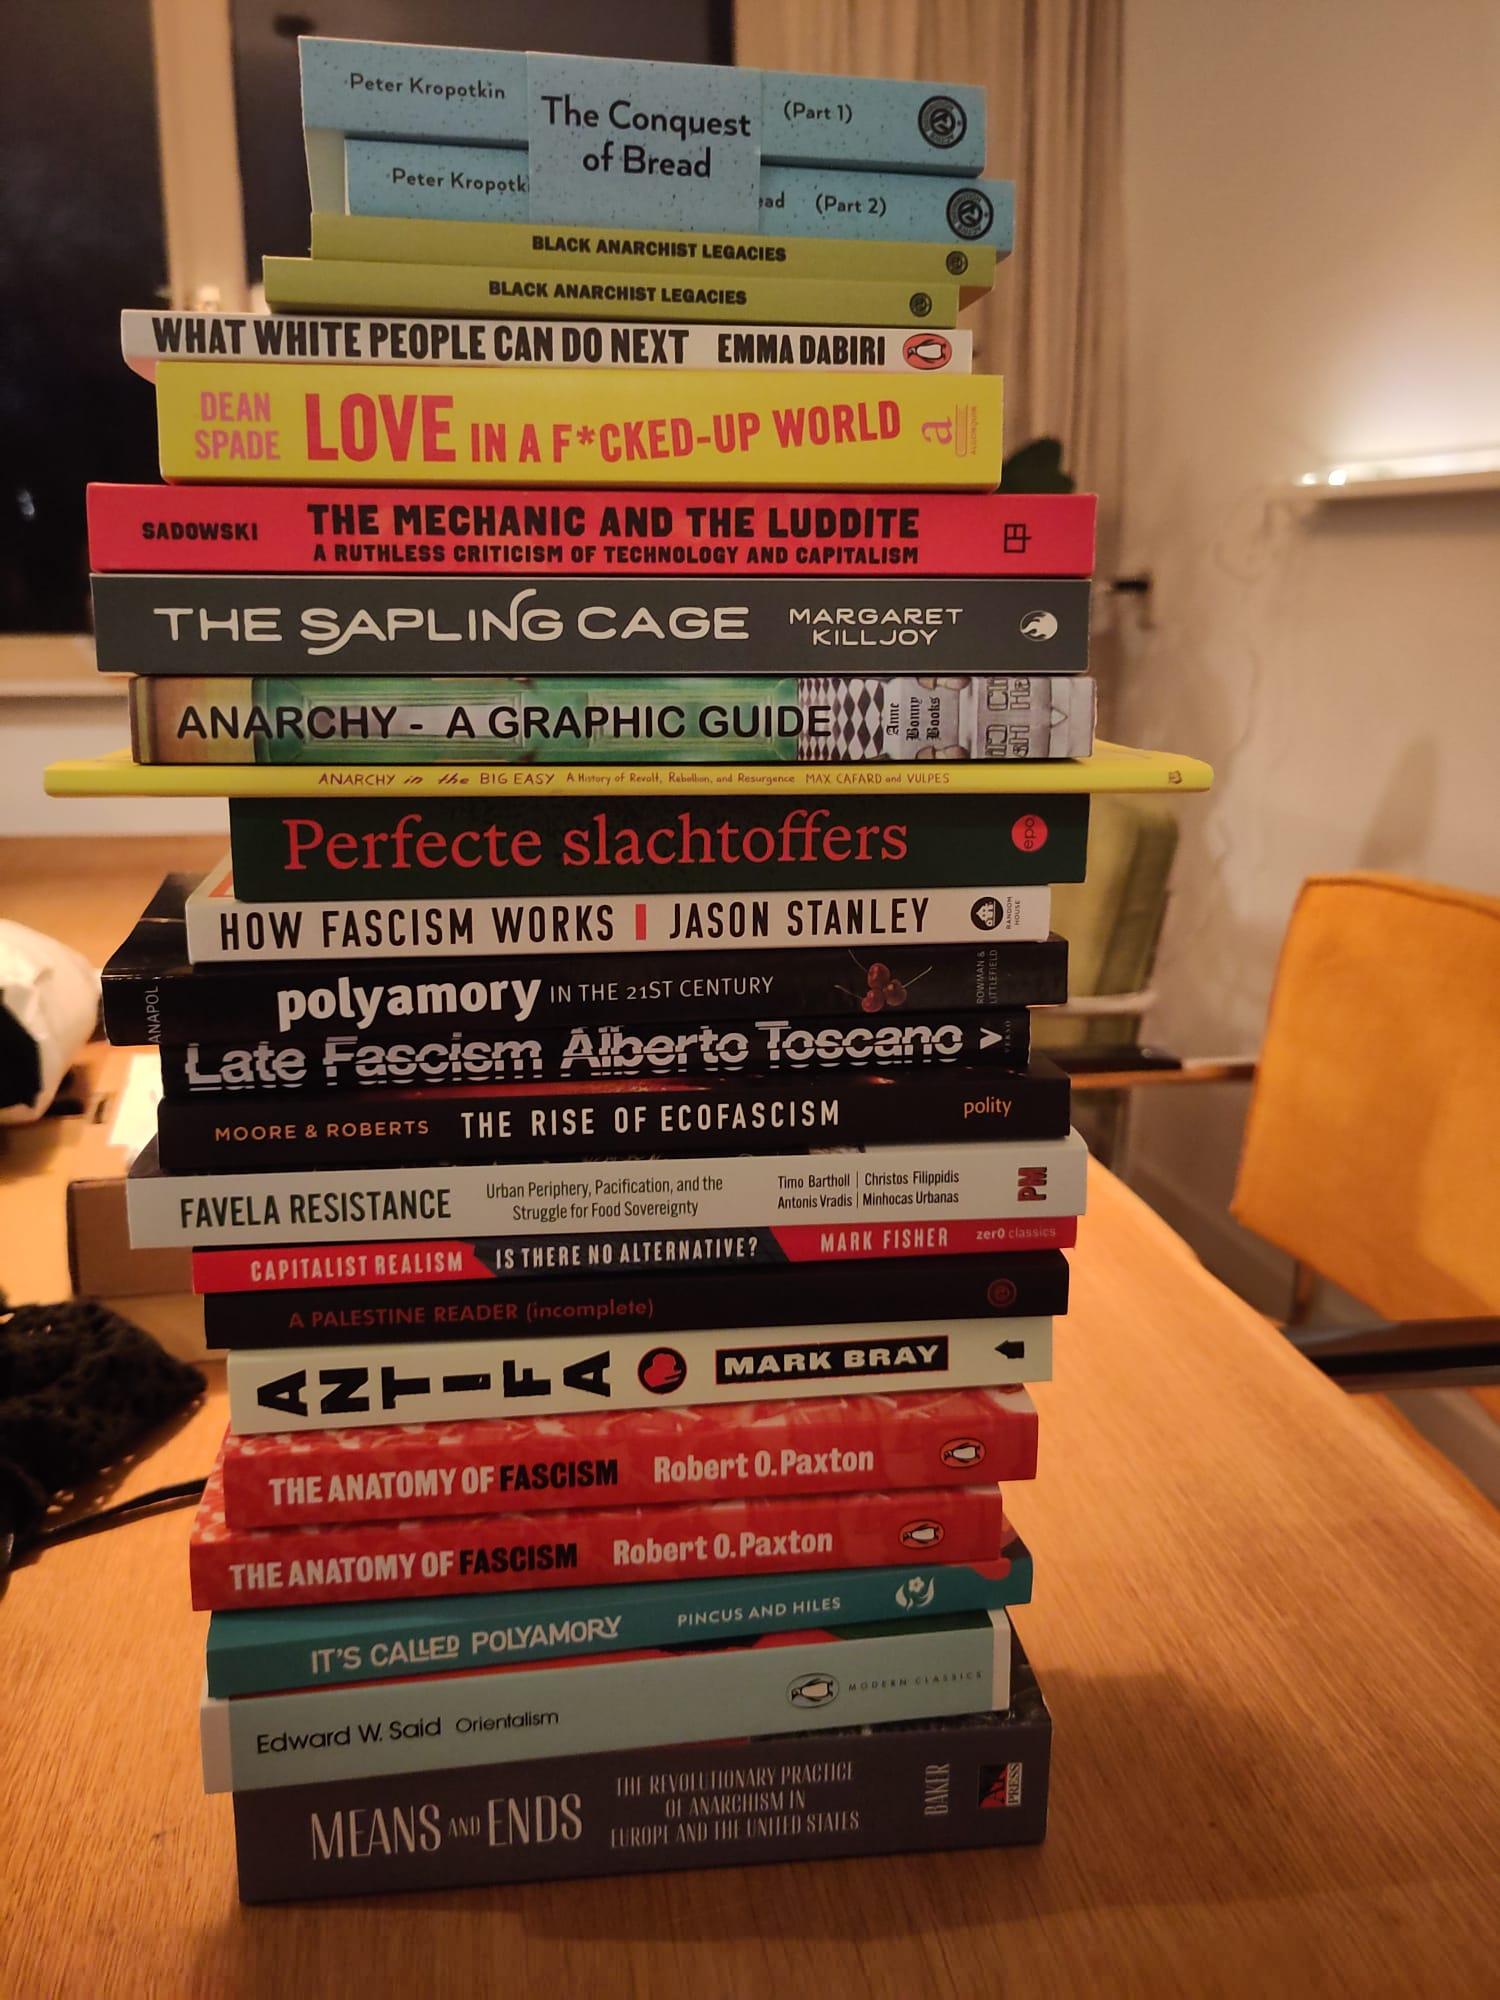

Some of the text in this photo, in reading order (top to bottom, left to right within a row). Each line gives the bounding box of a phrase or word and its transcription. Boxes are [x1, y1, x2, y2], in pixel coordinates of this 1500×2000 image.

[350, 73, 505, 99] Peter Kropotkin
[541, 95, 751, 140] The Conquest
[784, 101, 853, 124] (Part 1)
[582, 142, 711, 178] of Bread
[532, 236, 786, 262] BLACK ANARCHIST LEGACIES
[152, 318, 885, 366] WHAT WHITE PEOPLE CAN DO NEXT EMMA DABIRI
[305, 393, 456, 462] LOVE
[471, 423, 506, 462] IN
[519, 423, 541, 463] A
[772, 400, 901, 448] WORLD
[142, 522, 258, 541] SADOWSKI
[314, 544, 918, 564] A RUTHLESS CRITICISM OF TECHNOLOGY AND CAPITALISM
[153, 589, 749, 656] THE SAPLING CAGE
[789, 608, 963, 625] MARGARET
[813, 629, 938, 646] KILLJOY
[177, 705, 831, 739] ANARCHY A GRAPHIC GUIDE
[886, 702, 899, 736] Anne
[926, 696, 941, 740] Books
[318, 773, 396, 786] ANARCHY
[404, 774, 423, 785] in
[438, 773, 469, 785] the
[480, 772, 508, 785] BIG
[514, 772, 554, 785] EASY
[567, 773, 574, 782] A
[578, 773, 611, 786] History
[615, 772, 625, 782] of
[716, 774, 733, 783] and
[738, 772, 795, 785] Resurgence
[806, 773, 830, 784] MAX
[836, 773, 882, 784] CAFARD
[886, 774, 902, 783] and
[907, 773, 950, 784] VULPES
[282, 808, 908, 871] Perfecte slachtoffers
[1024, 817, 1036, 849] epo
[220, 898, 929, 950] HOW FASCISM WORKS JASON STANLEY
[145, 985, 160, 1043] ANAPOL
[277, 976, 774, 1032] polyamory IN THE 21ST CENTURY
[185, 1020, 964, 1091] Late Fascism Alberto Toscano
[461, 1100, 839, 1139] THE RISE OF ECOFASCISM
[964, 1096, 1012, 1119] polity
[215, 1120, 430, 1142] MOORE & ROBERTS
[486, 1176, 722, 1200] Urban Periphery, Pacification, and the
[778, 1170, 959, 1189] Timo Bartholl Christos Filippidis
[1017, 1167, 1047, 1201] PM
[180, 1189, 451, 1228] FAVELA RESISTANCE
[512, 1200, 698, 1222] Struggle for Food Sovereignty
[778, 1190, 959, 1209] Antonis Vradis Minhocas Urbanas
[251, 1227, 948, 1282] CAPITALIST REALISM IS THERE NO ALTERNATIVE? MARK FISHER
[289, 1298, 654, 1329] A PALESTINE READER (incomplete)
[257, 1344, 939, 1417] ANTIFA MARK BRAY
[269, 1449, 874, 1505] THE ANATOMY OF FASCISM Robert O. Paxton
[311, 1615, 622, 1674] IT'S CALLED POLYAMORY
[849, 1671, 983, 1691] MODERN CLASSICS
[256, 1716, 441, 1754] Edward W. Said
[456, 1709, 559, 1734] Orientalism
[616, 1761, 855, 1796] THE REVOLUTIONARY PRACTICE
[924, 1763, 949, 1815] BAKER
[1008, 1762, 1019, 1804] PRESS
[665, 1791, 806, 1818] OF ANARCHISM IN
